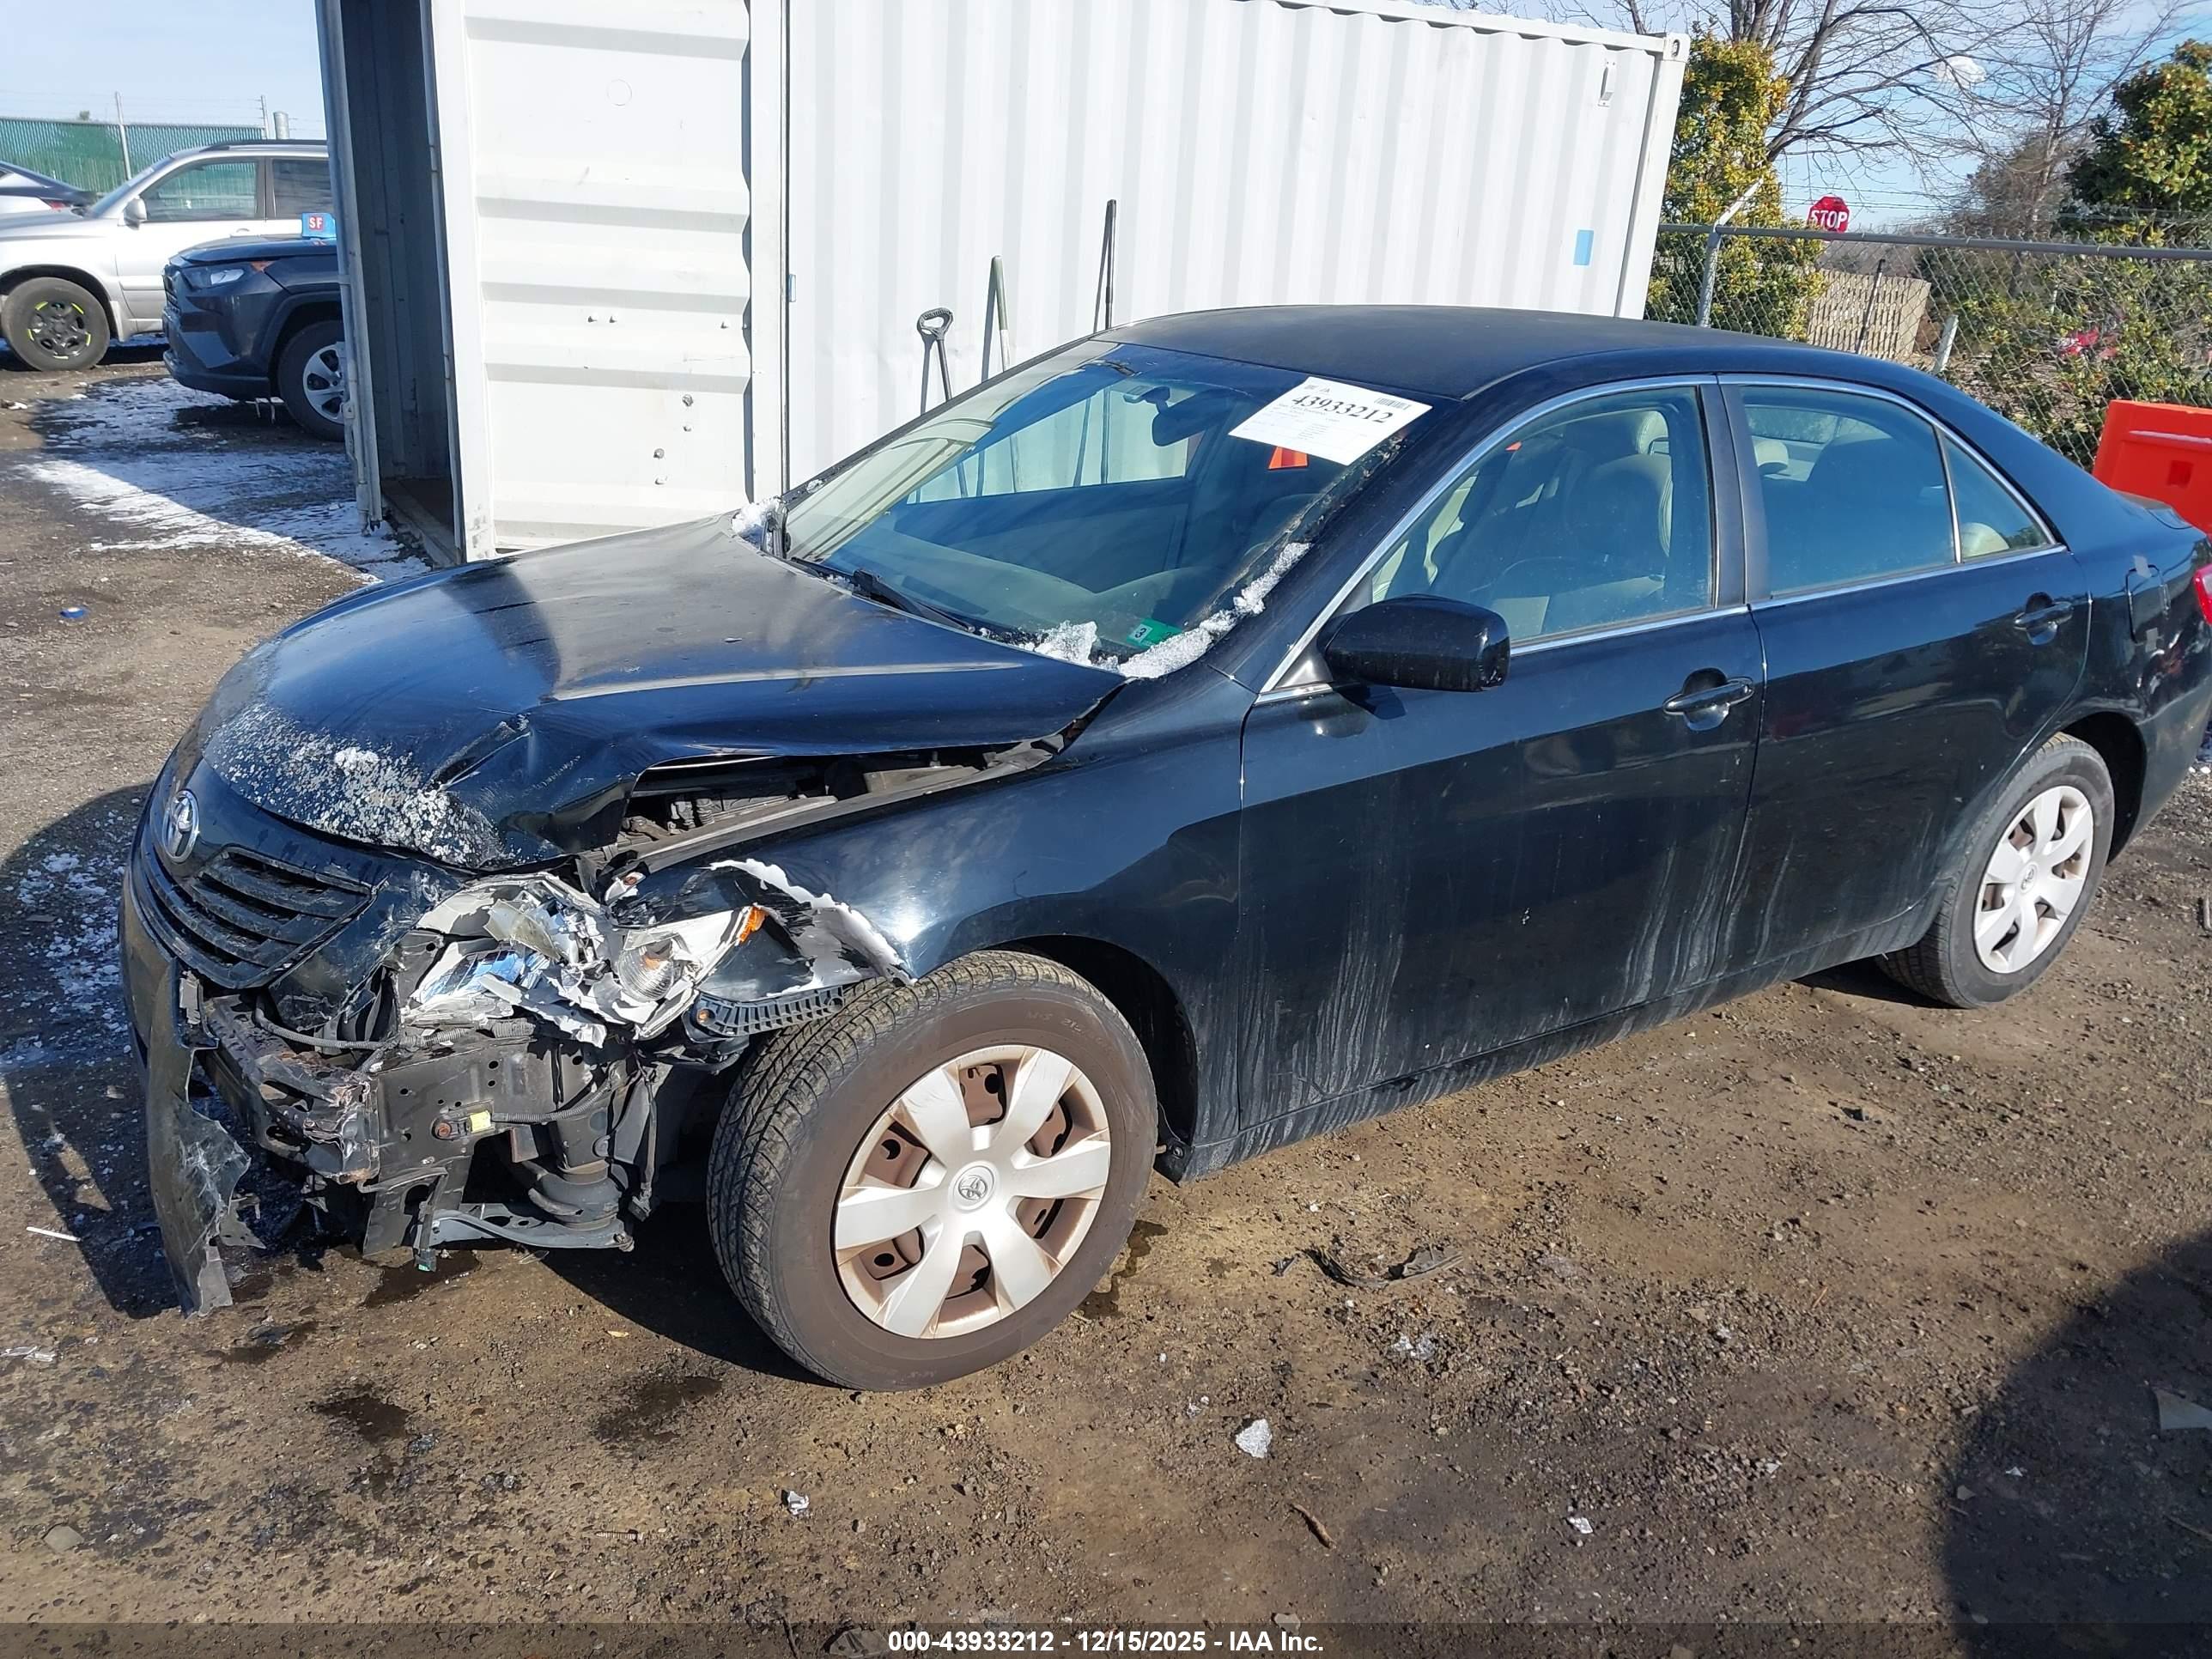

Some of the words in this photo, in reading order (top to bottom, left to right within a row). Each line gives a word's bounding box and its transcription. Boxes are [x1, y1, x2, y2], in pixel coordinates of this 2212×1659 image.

[308, 216, 323, 229] SF
[1810, 210, 1848, 229] STOP
[1291, 394, 1394, 424] 43933212
